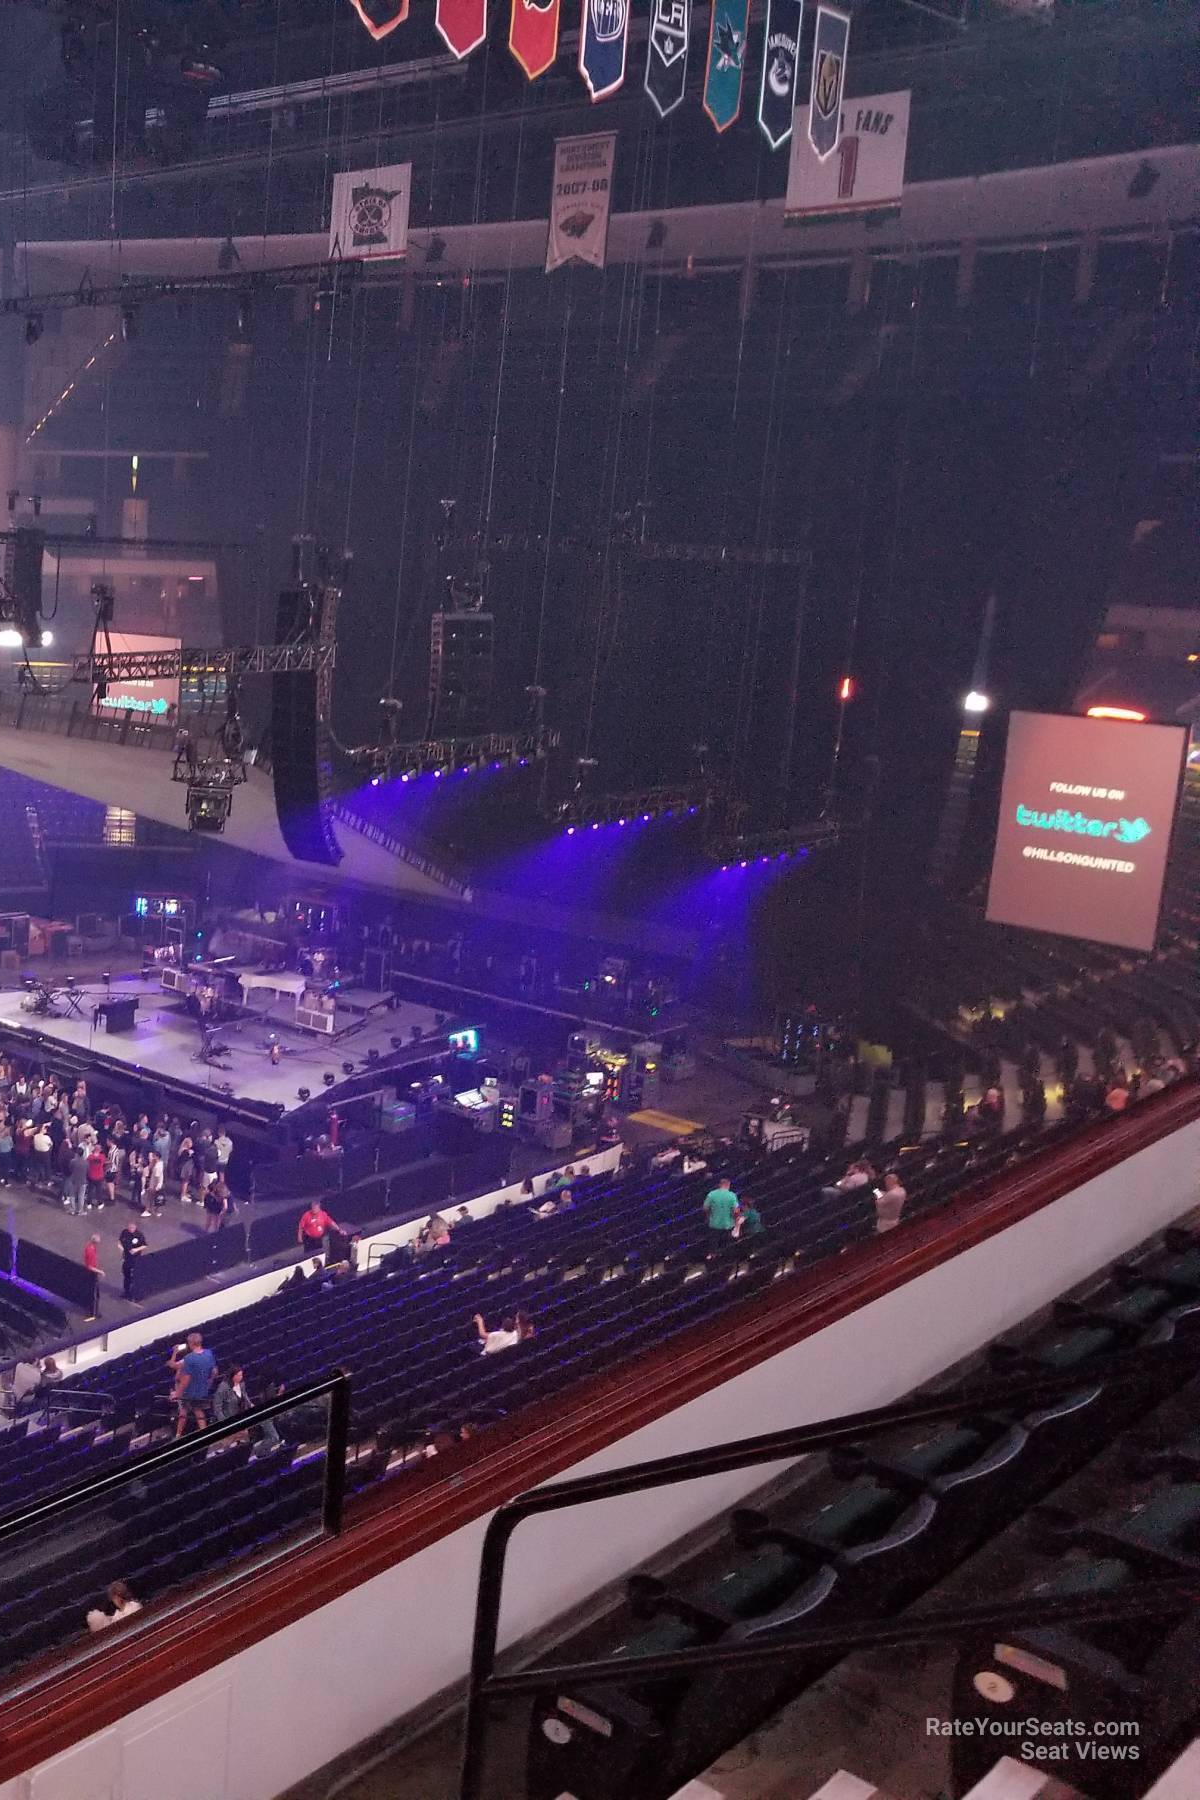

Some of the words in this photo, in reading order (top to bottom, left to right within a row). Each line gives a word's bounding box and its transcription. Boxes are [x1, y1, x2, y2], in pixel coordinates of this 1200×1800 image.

[659, 0, 685, 27] LA
[855, 109, 894, 135] FANS
[837, 136, 859, 199] 1
[556, 179, 609, 196] 2007-08
[1049, 781, 1091, 797] FOLLOW
[1092, 786, 1108, 799] US
[1108, 788, 1125, 801] ON
[1016, 803, 1118, 838] twitter
[1022, 845, 1136, 874] @HILLSONGUNITED
